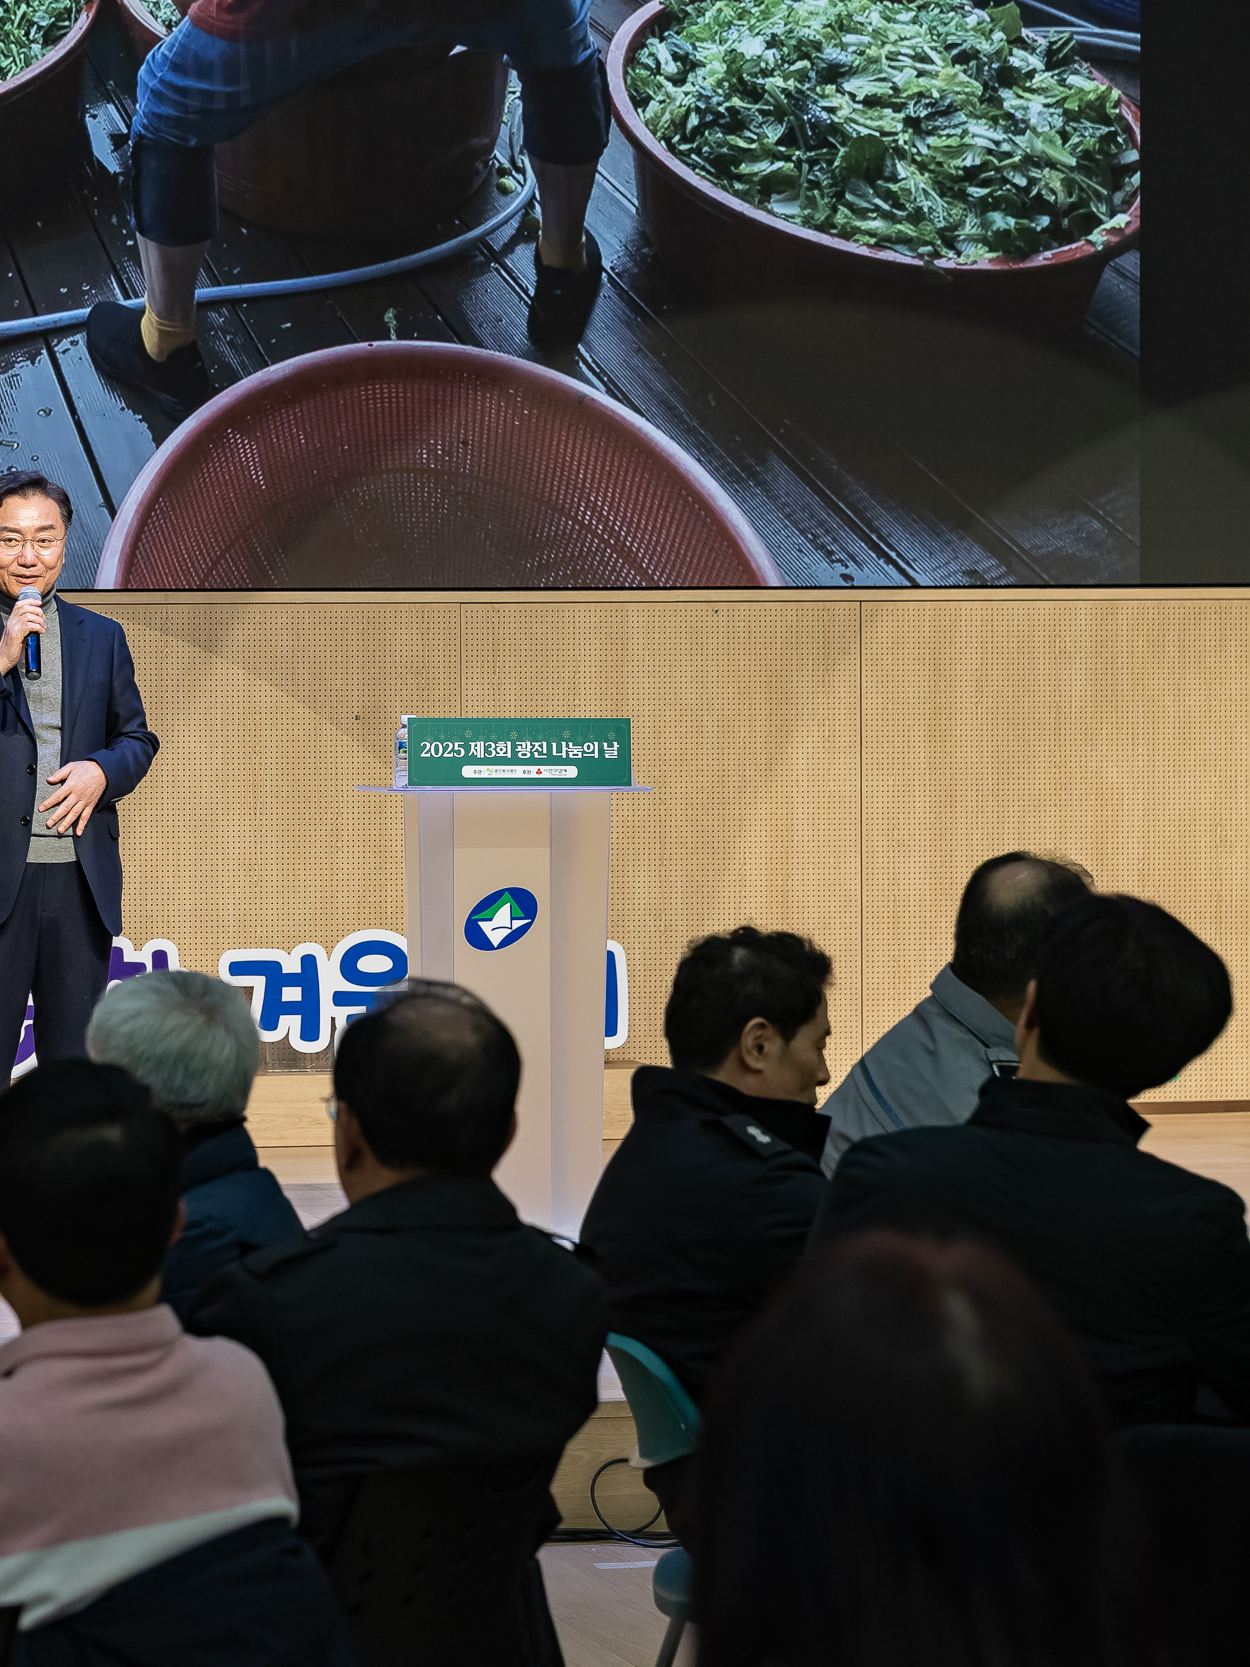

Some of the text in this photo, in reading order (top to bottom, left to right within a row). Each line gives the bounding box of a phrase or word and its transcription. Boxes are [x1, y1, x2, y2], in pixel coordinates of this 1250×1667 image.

[419, 741, 620, 759] 2025 제3회 광진 나눔의 날
